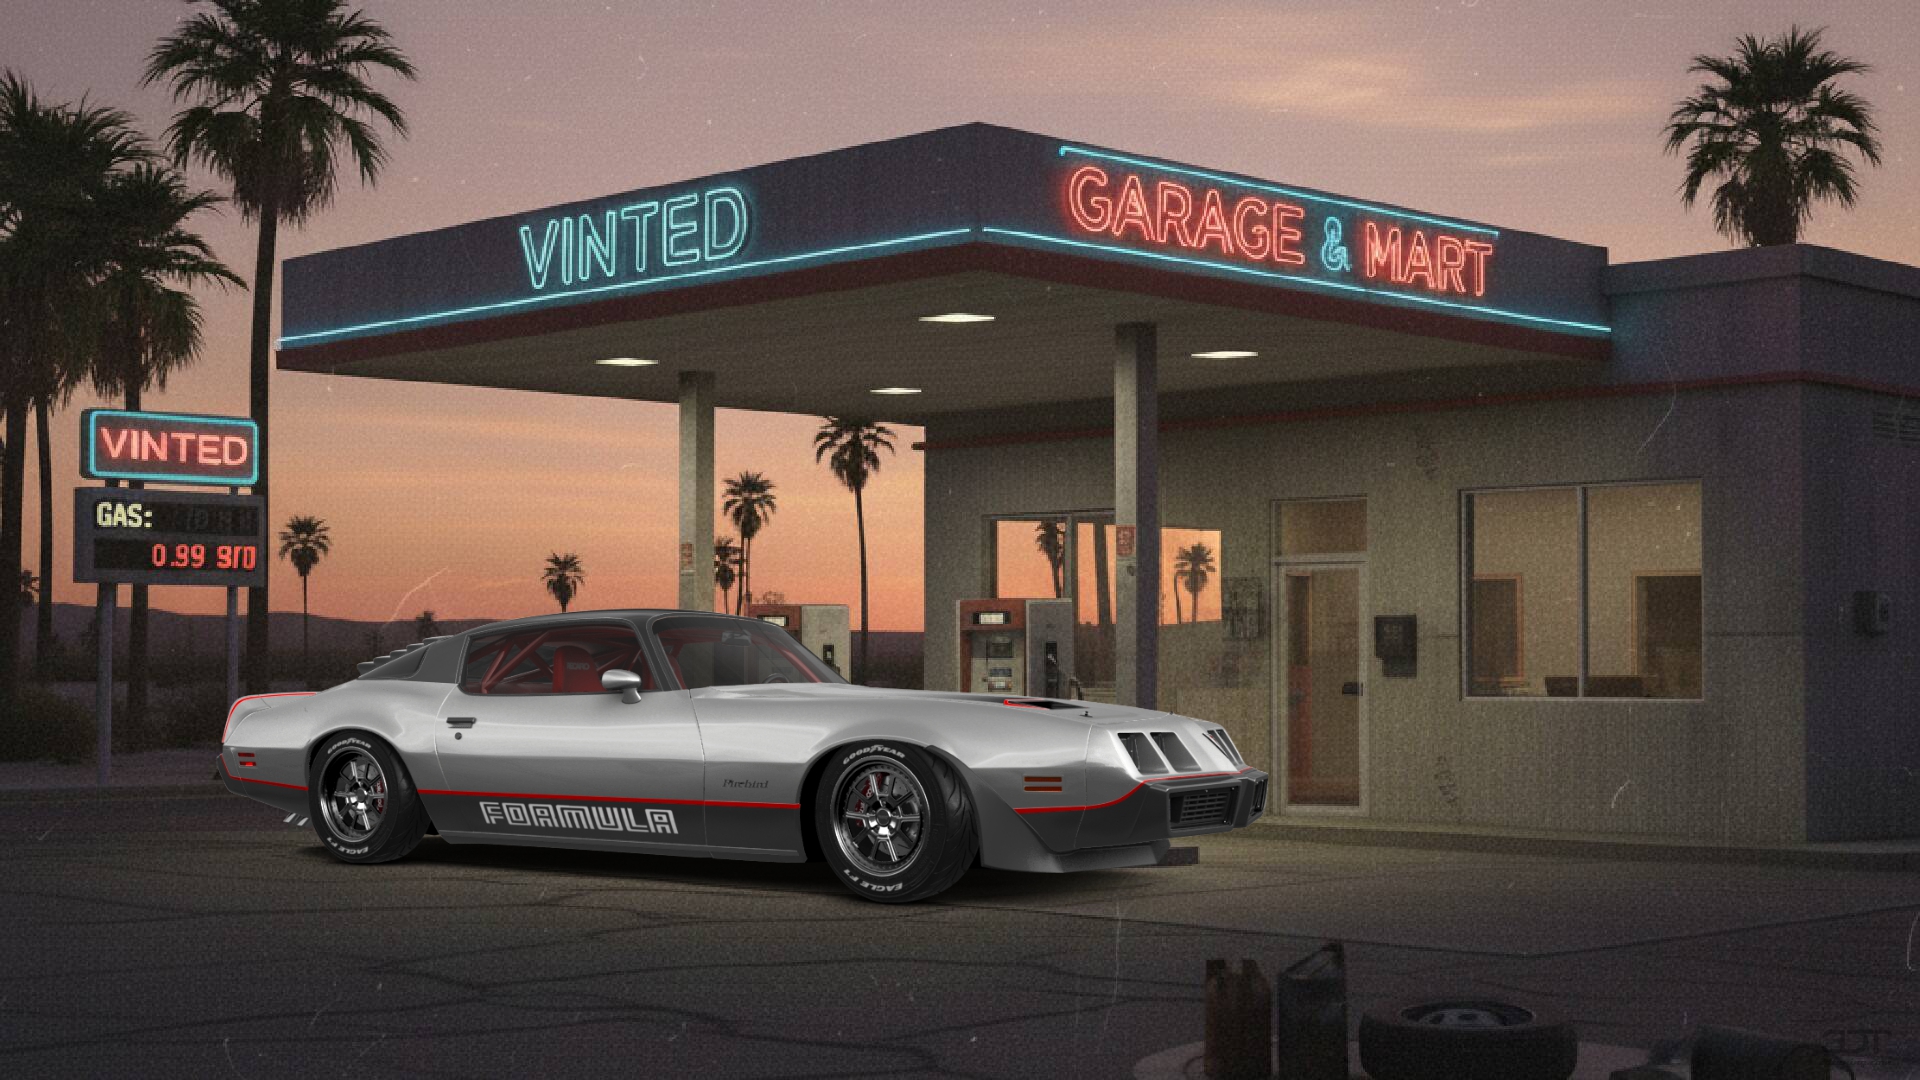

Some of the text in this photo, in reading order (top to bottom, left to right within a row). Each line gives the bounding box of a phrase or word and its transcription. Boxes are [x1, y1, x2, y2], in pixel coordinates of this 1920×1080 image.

[519, 187, 748, 289] VINTED
[1068, 166, 1494, 297] GARAGE & MART
[100, 426, 248, 466] VINTED
[96, 501, 153, 528] GAS:
[152, 543, 206, 568] 0.99
[327, 737, 371, 754] GOODYEAR
[843, 744, 906, 765] GOODYEAR
[479, 801, 679, 835] FORMULA
[860, 881, 903, 892] EAGLE
